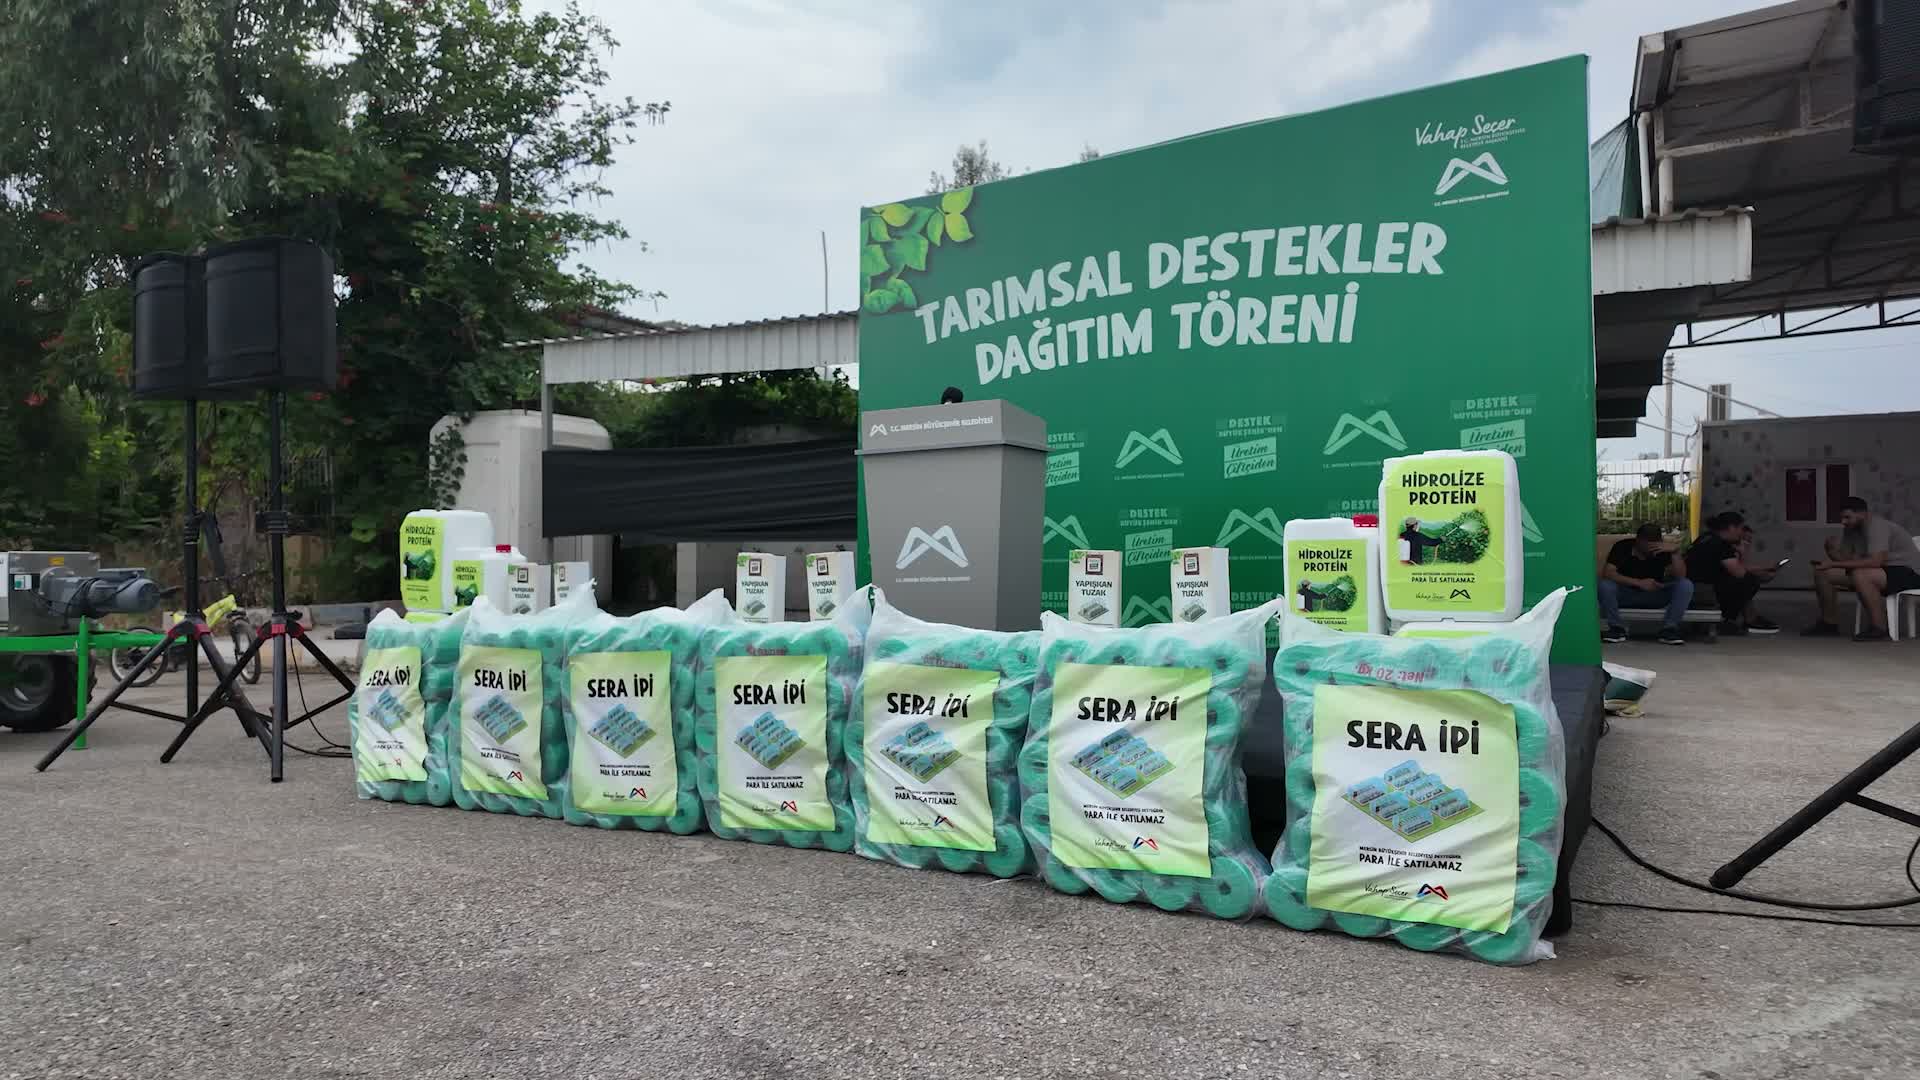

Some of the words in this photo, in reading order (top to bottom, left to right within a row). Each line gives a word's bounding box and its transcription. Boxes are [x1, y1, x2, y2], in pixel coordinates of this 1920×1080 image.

[1415, 122, 1468, 149] Vahap
[1471, 114, 1516, 136] Seçer
[915, 250, 1132, 345] TARIMSAL
[1148, 221, 1448, 289] DESTEKLER
[975, 308, 1153, 385] DAĞITIM
[1171, 281, 1359, 349] TÖRENİ
[1466, 396, 1518, 409] DESTEK
[1229, 415, 1271, 429] DESTEK
[1048, 432, 1075, 443] ESTEK
[1469, 427, 1514, 444] Üretim
[1231, 443, 1268, 459] Üretim
[1048, 457, 1072, 470] retim
[1226, 458, 1274, 477] Çiftçiden
[1402, 469, 1485, 488] HİDROLİZE
[1409, 487, 1477, 505] PROTEİN
[1129, 508, 1168, 518] DESTEK
[1341, 499, 1379, 511] DESTE
[405, 525, 435, 535] HİDROLİZE
[408, 536, 432, 546] PROTEİN
[1298, 548, 1353, 560] HİDROLİZE
[1304, 560, 1348, 572] PROTEİN
[1075, 580, 1112, 589] YAPIŞKAN
[1176, 580, 1209, 589] YAPIŞKAN
[395, 665, 411, 686] İPİ
[474, 669, 504, 690] SERA
[509, 668, 527, 692] İPİ
[587, 678, 628, 698] SERA
[634, 673, 653, 698] İPİ
[733, 684, 777, 706] SERA
[783, 679, 806, 705] İPİ
[887, 692, 936, 717] SERA
[941, 693, 969, 718] İPİ
[1077, 696, 1136, 723] SERA
[1145, 695, 1180, 722] İPİ
[1347, 720, 1427, 752] SERA
[1440, 719, 1480, 755] İPİ
[1084, 810, 1104, 819] PARA
[1106, 811, 1118, 821] İLE
[1120, 814, 1165, 824] SATILAMAZ
[1360, 853, 1384, 865] PARA
[1387, 855, 1401, 867] İLE
[1404, 859, 1462, 872] SATILAMAZ
